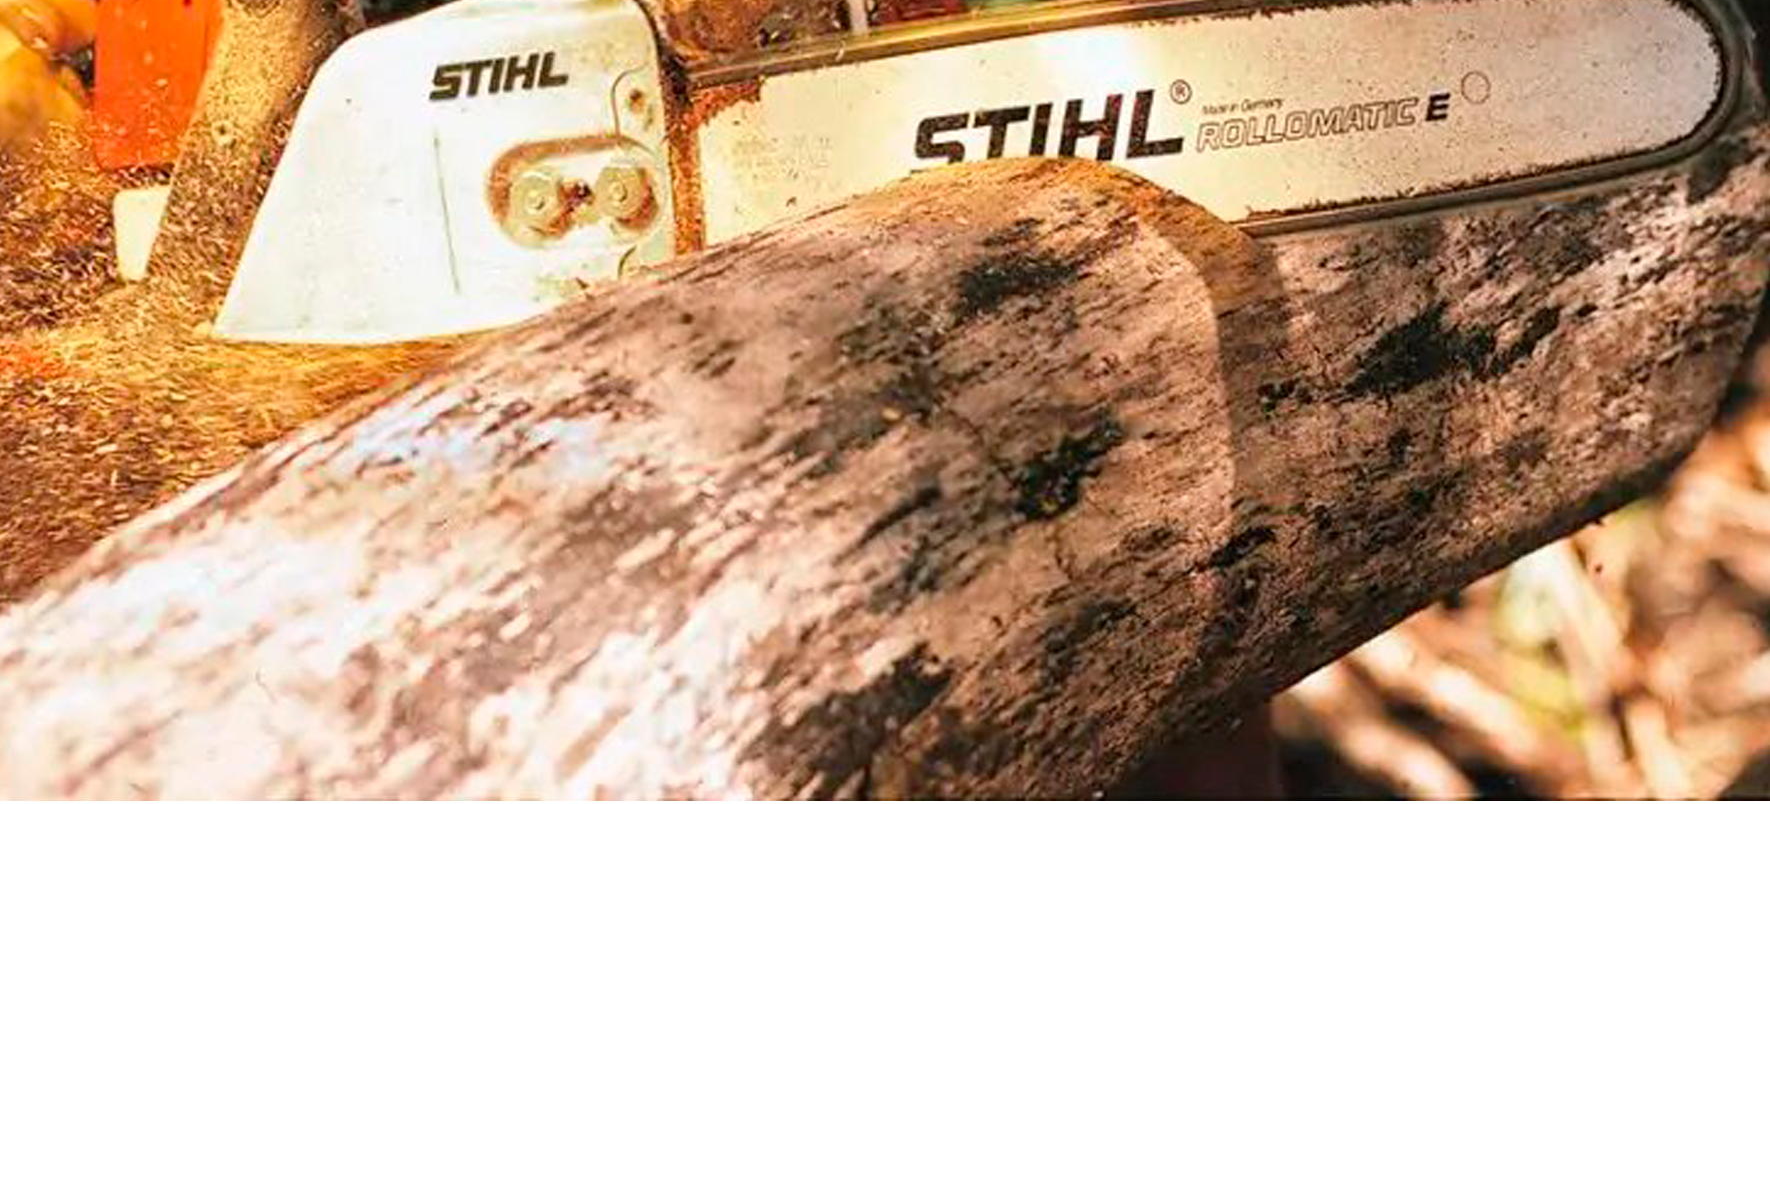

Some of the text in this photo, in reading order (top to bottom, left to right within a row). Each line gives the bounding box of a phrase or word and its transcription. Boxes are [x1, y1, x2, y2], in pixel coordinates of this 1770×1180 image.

[429, 51, 569, 101] STIHL
[910, 89, 1184, 173] STIHL
[1197, 93, 1451, 152] ROLLOMATIC E
